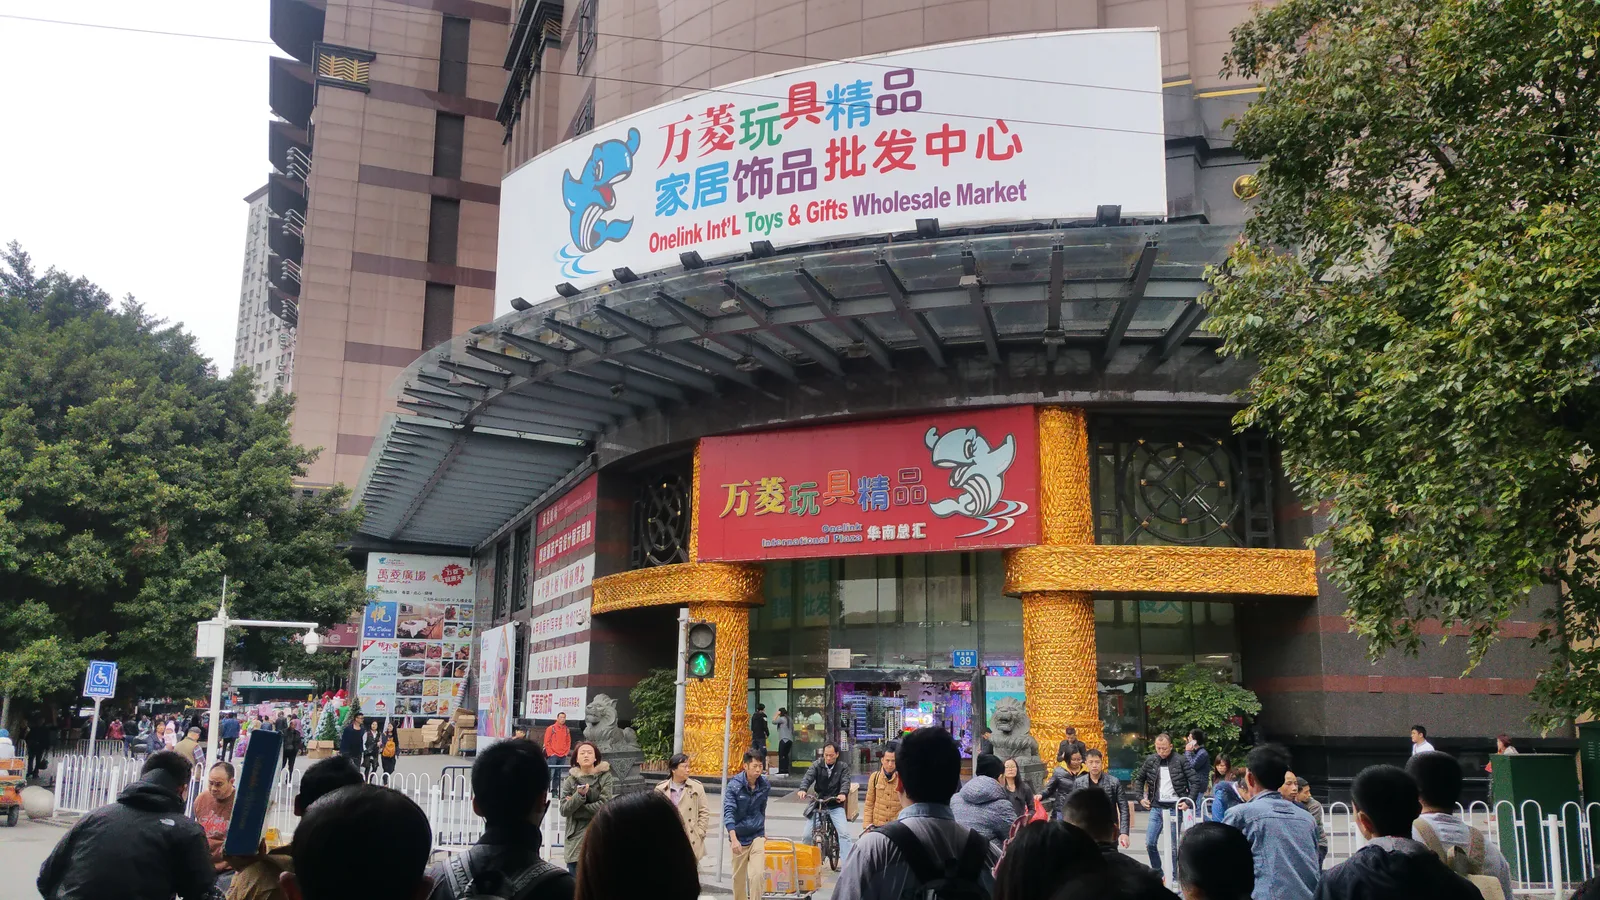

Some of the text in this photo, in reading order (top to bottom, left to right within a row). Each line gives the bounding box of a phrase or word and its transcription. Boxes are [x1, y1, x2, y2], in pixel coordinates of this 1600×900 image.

[657, 68, 922, 170] 万菱玩具精品
[655, 118, 1023, 217] 家居饰品批发中心
[649, 179, 1026, 253] Onelink Int'L Toys & Gifts Wholesale Market
[718, 466, 928, 518] 万菱玩具精品
[761, 534, 863, 548] International Plaza
[821, 522, 863, 534] Onelink
[867, 523, 927, 542] 华南总汇
[959, 657, 971, 666] 39
